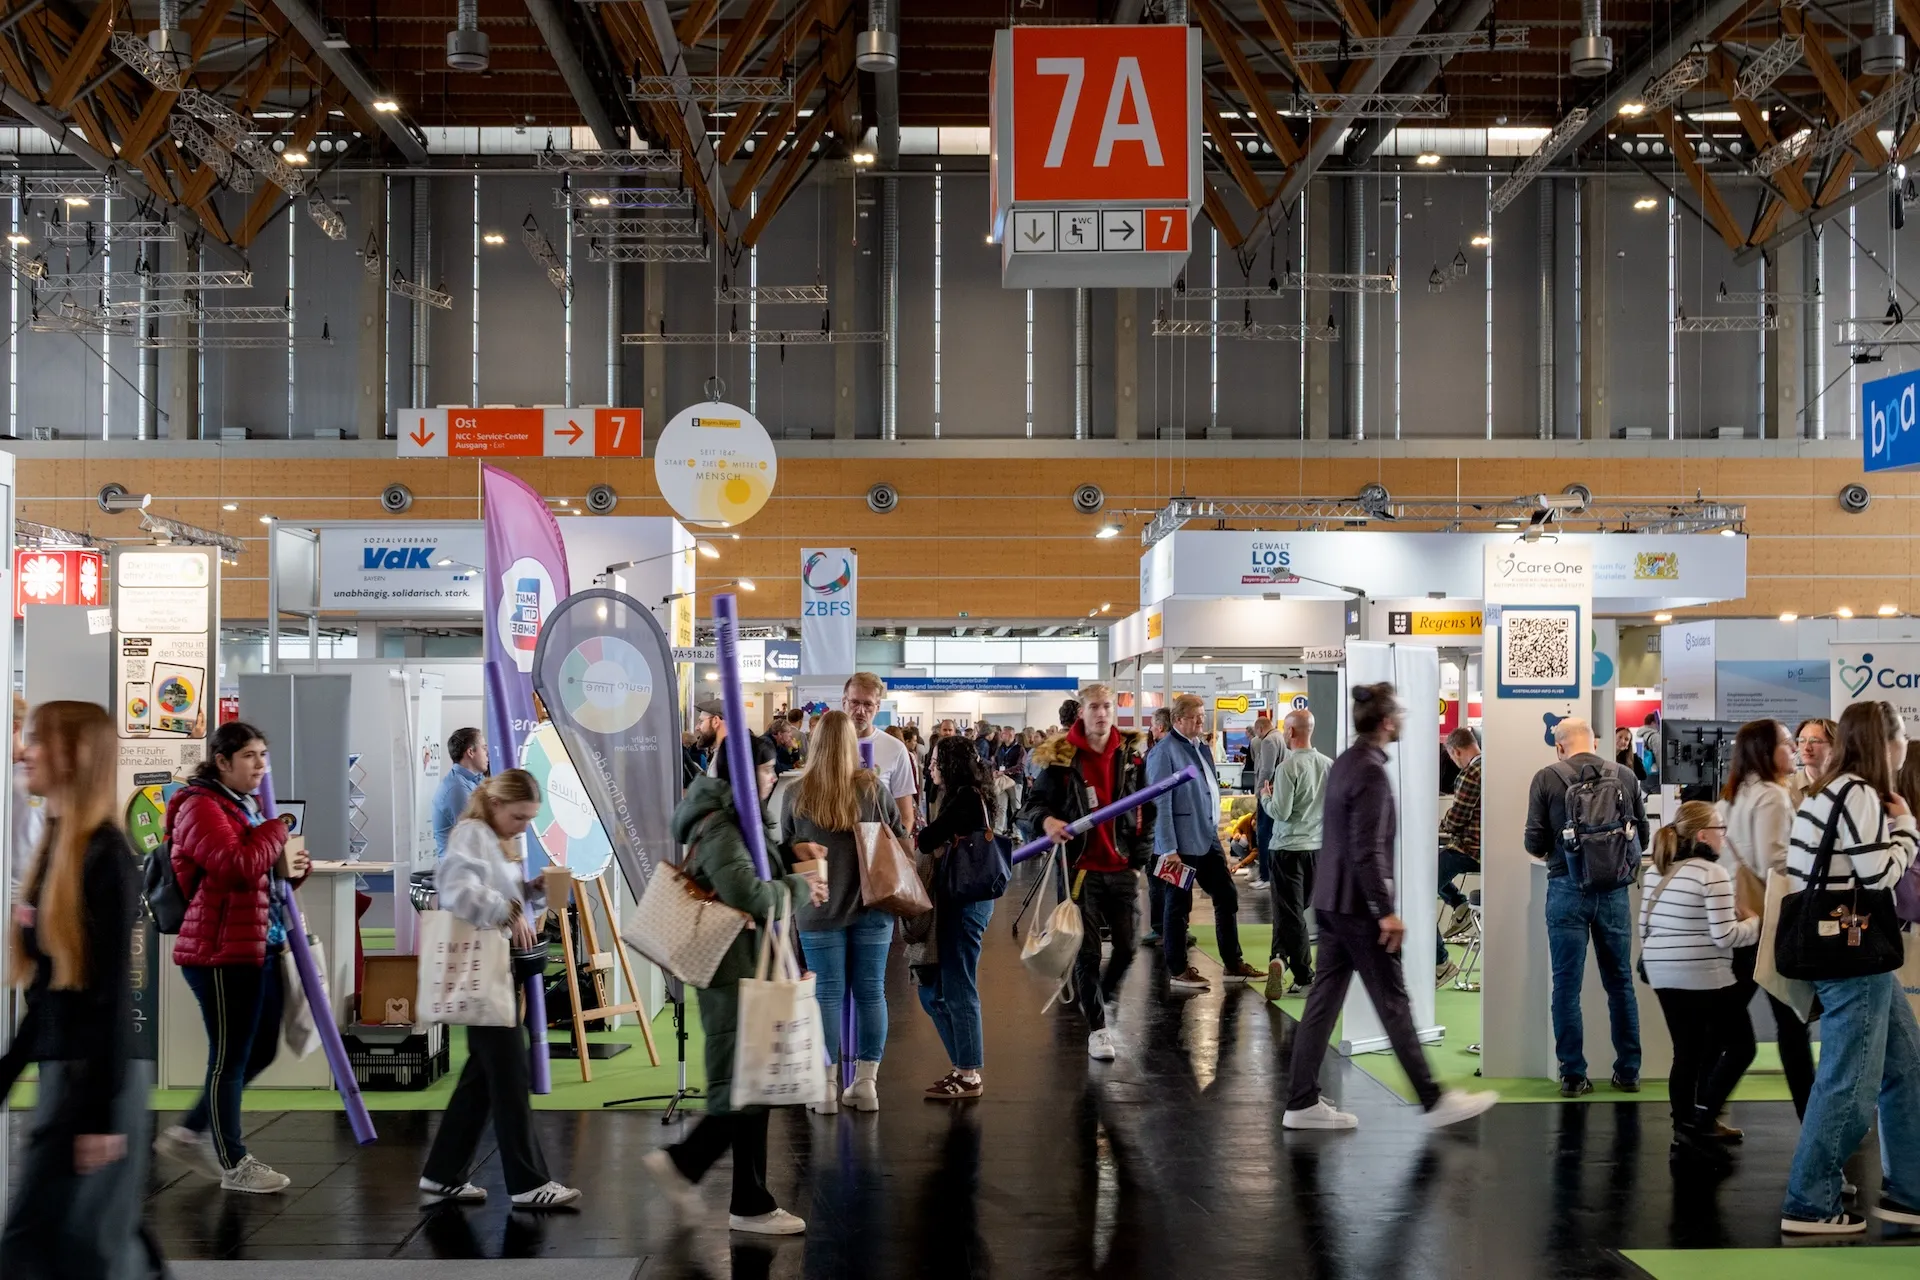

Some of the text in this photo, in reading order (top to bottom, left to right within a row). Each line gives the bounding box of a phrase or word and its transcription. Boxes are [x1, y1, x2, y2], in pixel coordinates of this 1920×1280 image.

[1036, 56, 1165, 168] 7A
[1159, 216, 1172, 243] 7
[455, 418, 477, 429] Ost
[1871, 382, 1915, 462] bpa
[611, 416, 626, 448] 7
[455, 442, 488, 450] Ausgang
[1252, 542, 1291, 550] GEWALT
[363, 547, 436, 570] VdK
[1252, 551, 1290, 565] LOS
[1517, 561, 1583, 574] Care One
[333, 588, 470, 600] unabhängig. solidarisch. stark.
[804, 601, 851, 616] ZBFS
[1420, 614, 1466, 632] Regens
[177, 649, 204, 658] Stores
[673, 650, 715, 659] 7A-518.26
[1306, 650, 1344, 659] 7A-518.25
[1877, 669, 1920, 689] Car
[137, 746, 165, 755] Filzuhr
